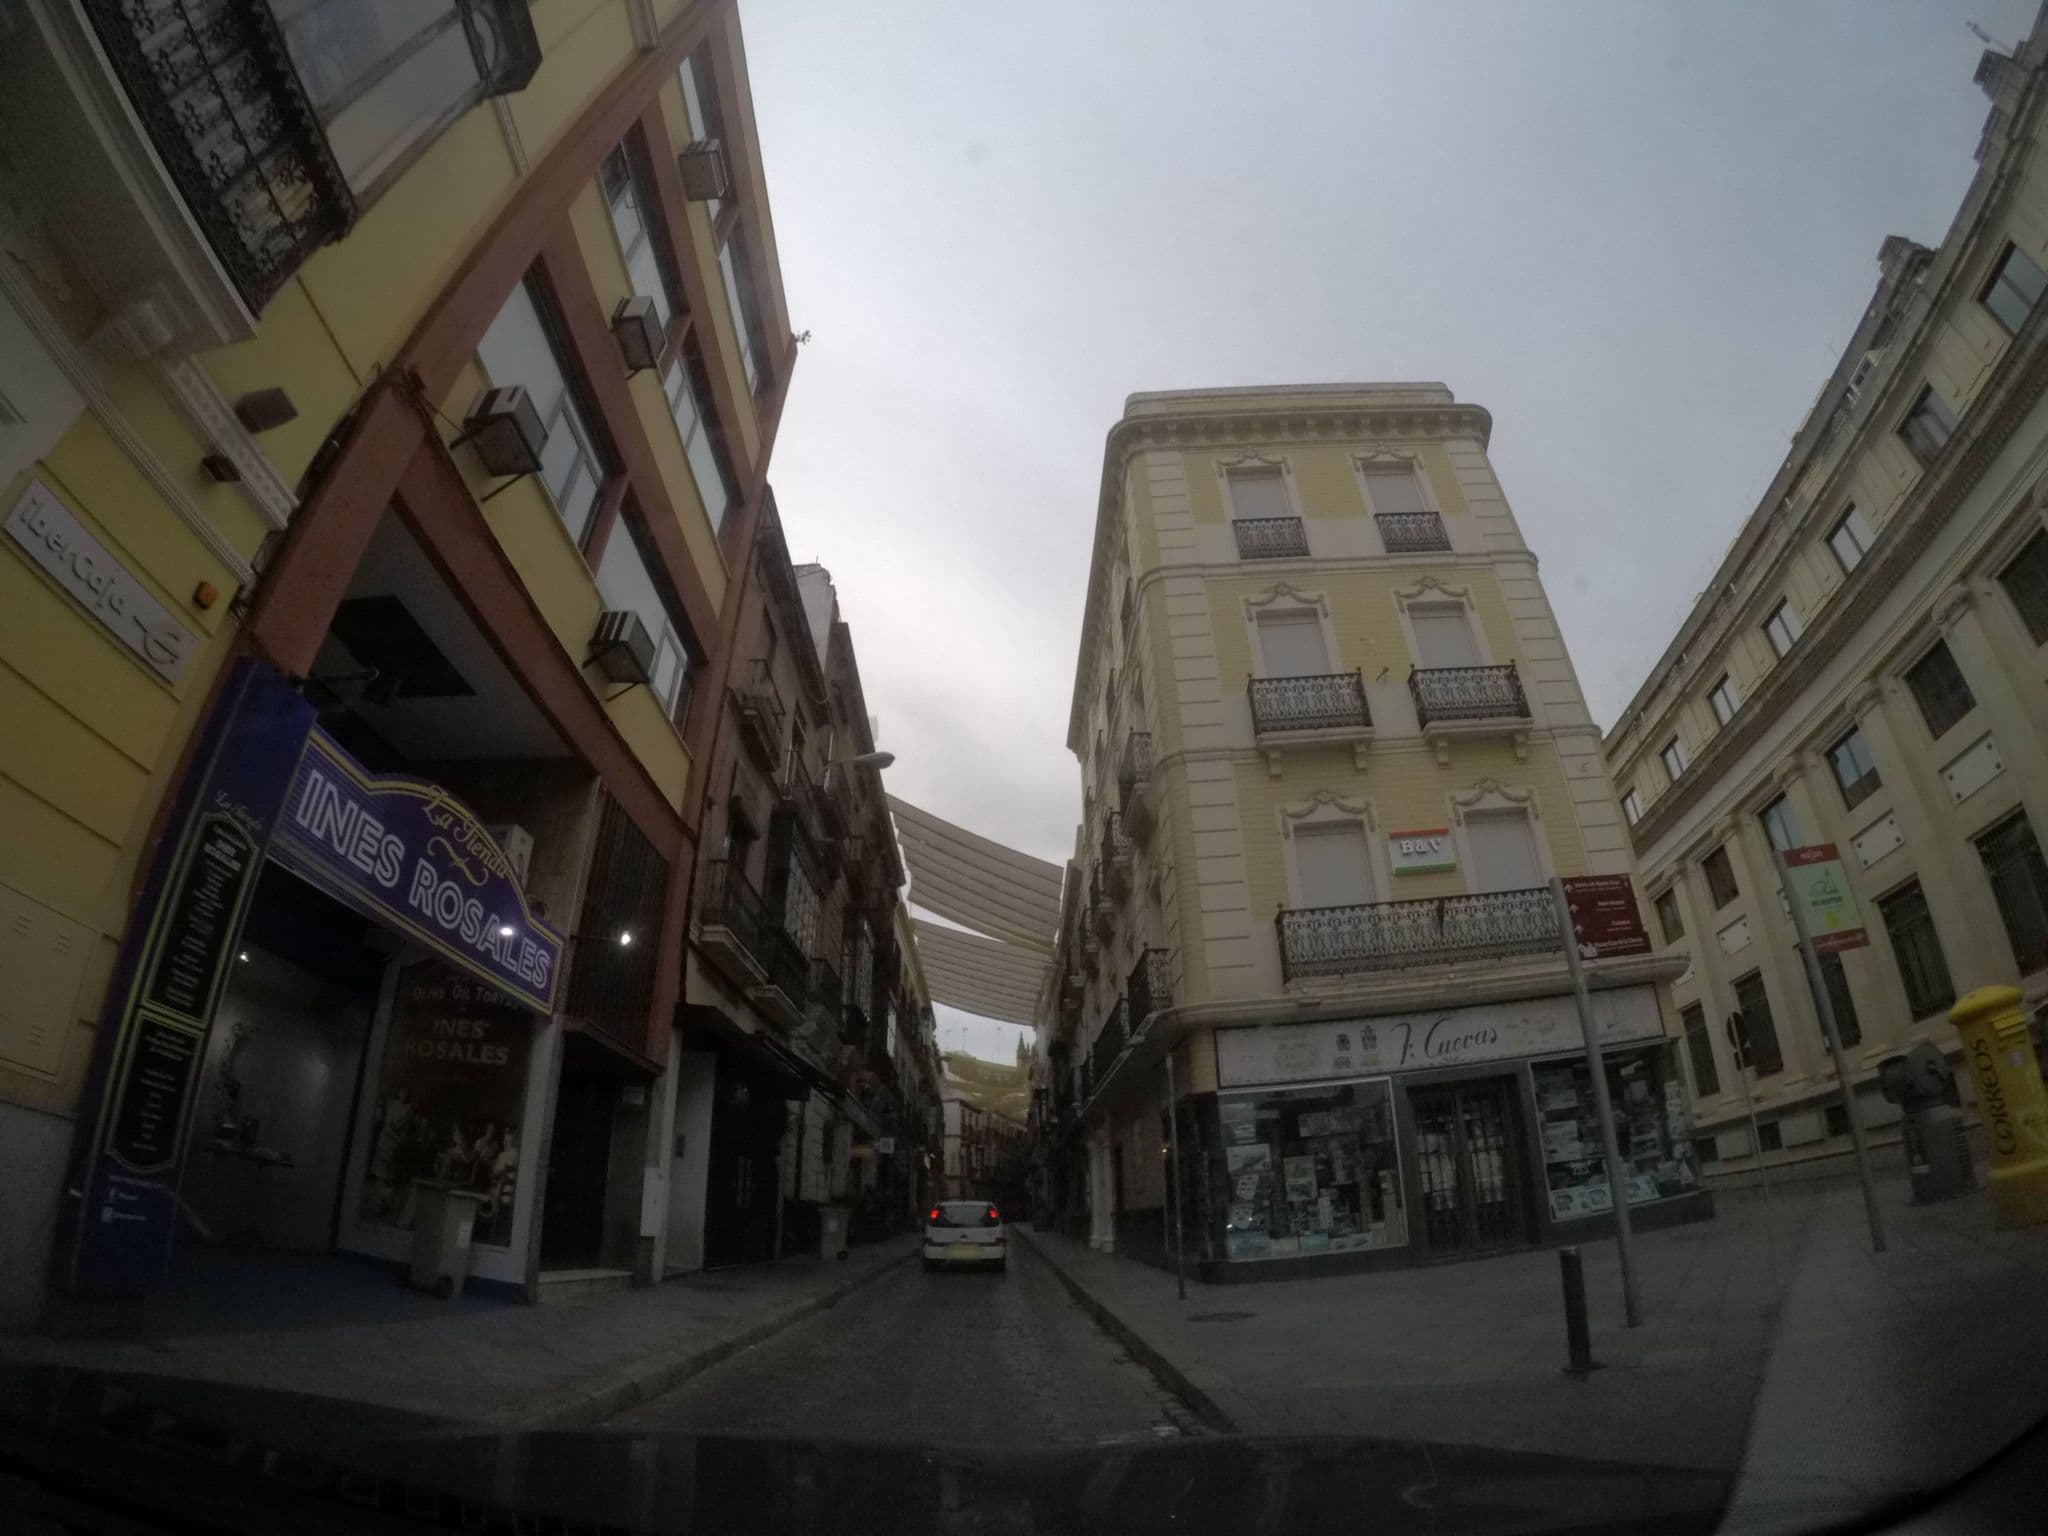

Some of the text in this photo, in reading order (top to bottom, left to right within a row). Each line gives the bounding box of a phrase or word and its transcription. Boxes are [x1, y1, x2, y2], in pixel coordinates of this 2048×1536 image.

[295, 769, 551, 989] INES ROSALES
[1424, 1018, 1498, 1059] Cuevas
